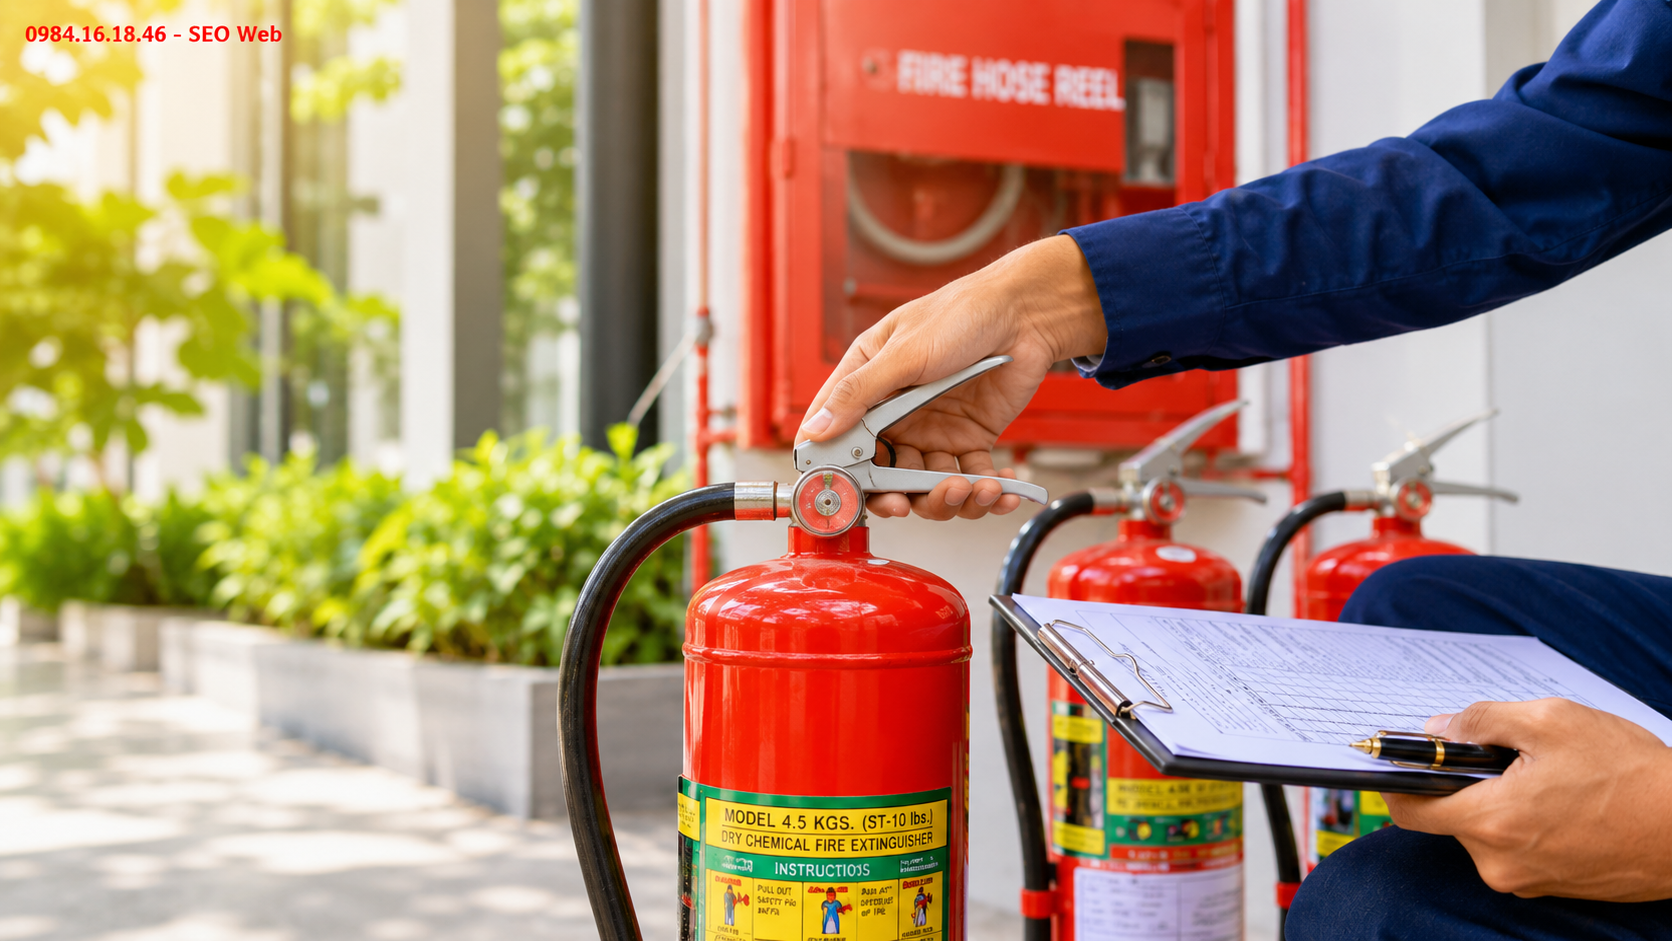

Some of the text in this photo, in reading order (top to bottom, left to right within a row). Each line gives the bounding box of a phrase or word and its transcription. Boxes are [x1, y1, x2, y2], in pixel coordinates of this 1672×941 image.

[897, 49, 1127, 112] FIRE HOSE REEL
[725, 808, 934, 833] MODEL 4.5 KGS. (ST-10 lbs.)
[721, 830, 934, 852] DRY CHEMICAL FIRE EXTINGUISHER
